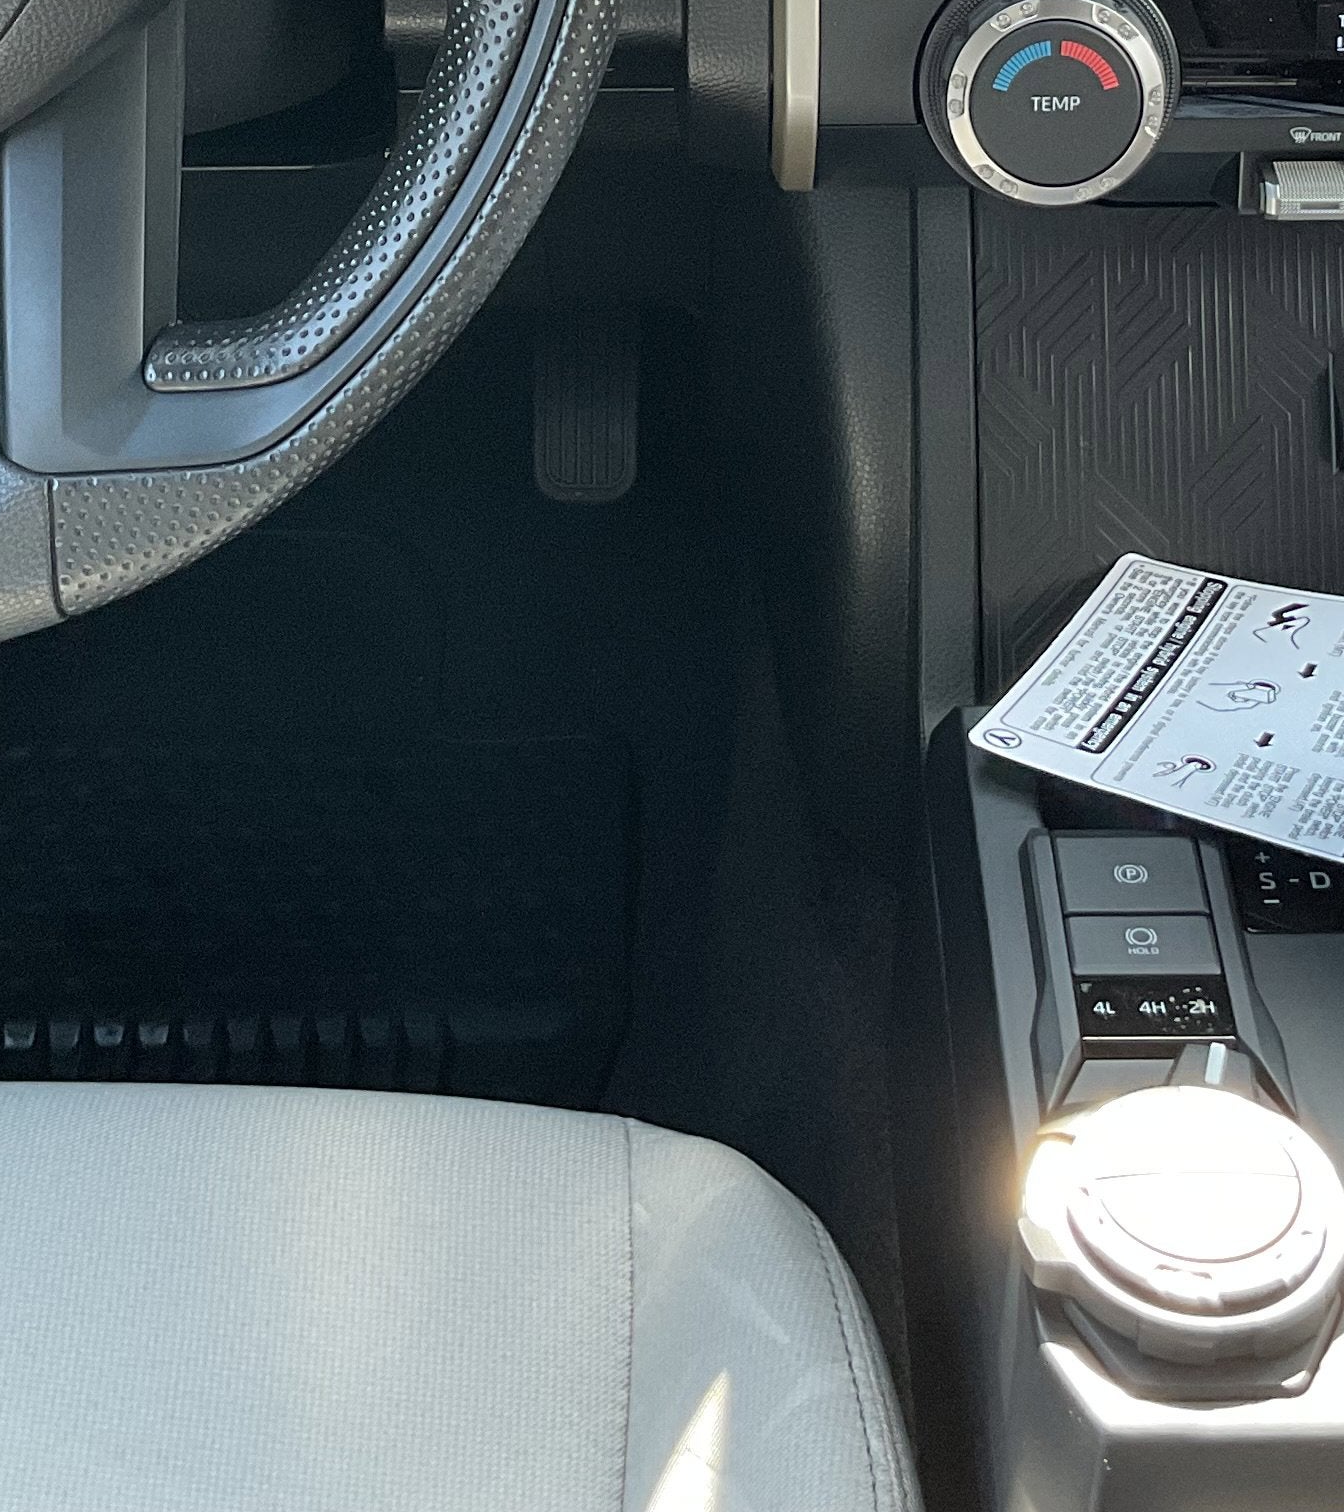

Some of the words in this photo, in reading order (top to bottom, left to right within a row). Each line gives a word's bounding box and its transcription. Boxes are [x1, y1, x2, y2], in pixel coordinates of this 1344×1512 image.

[1031, 96, 1081, 112] TEMP
[1310, 131, 1343, 144] FRONT
[1186, 581, 1223, 613] Stopping
[1258, 871, 1277, 890] S
[1309, 870, 1332, 890] D
[1127, 946, 1160, 955] HOLD
[1092, 1001, 1116, 1016] 4L
[1138, 1000, 1168, 1015] 4H
[1188, 999, 1216, 1015] 2H
